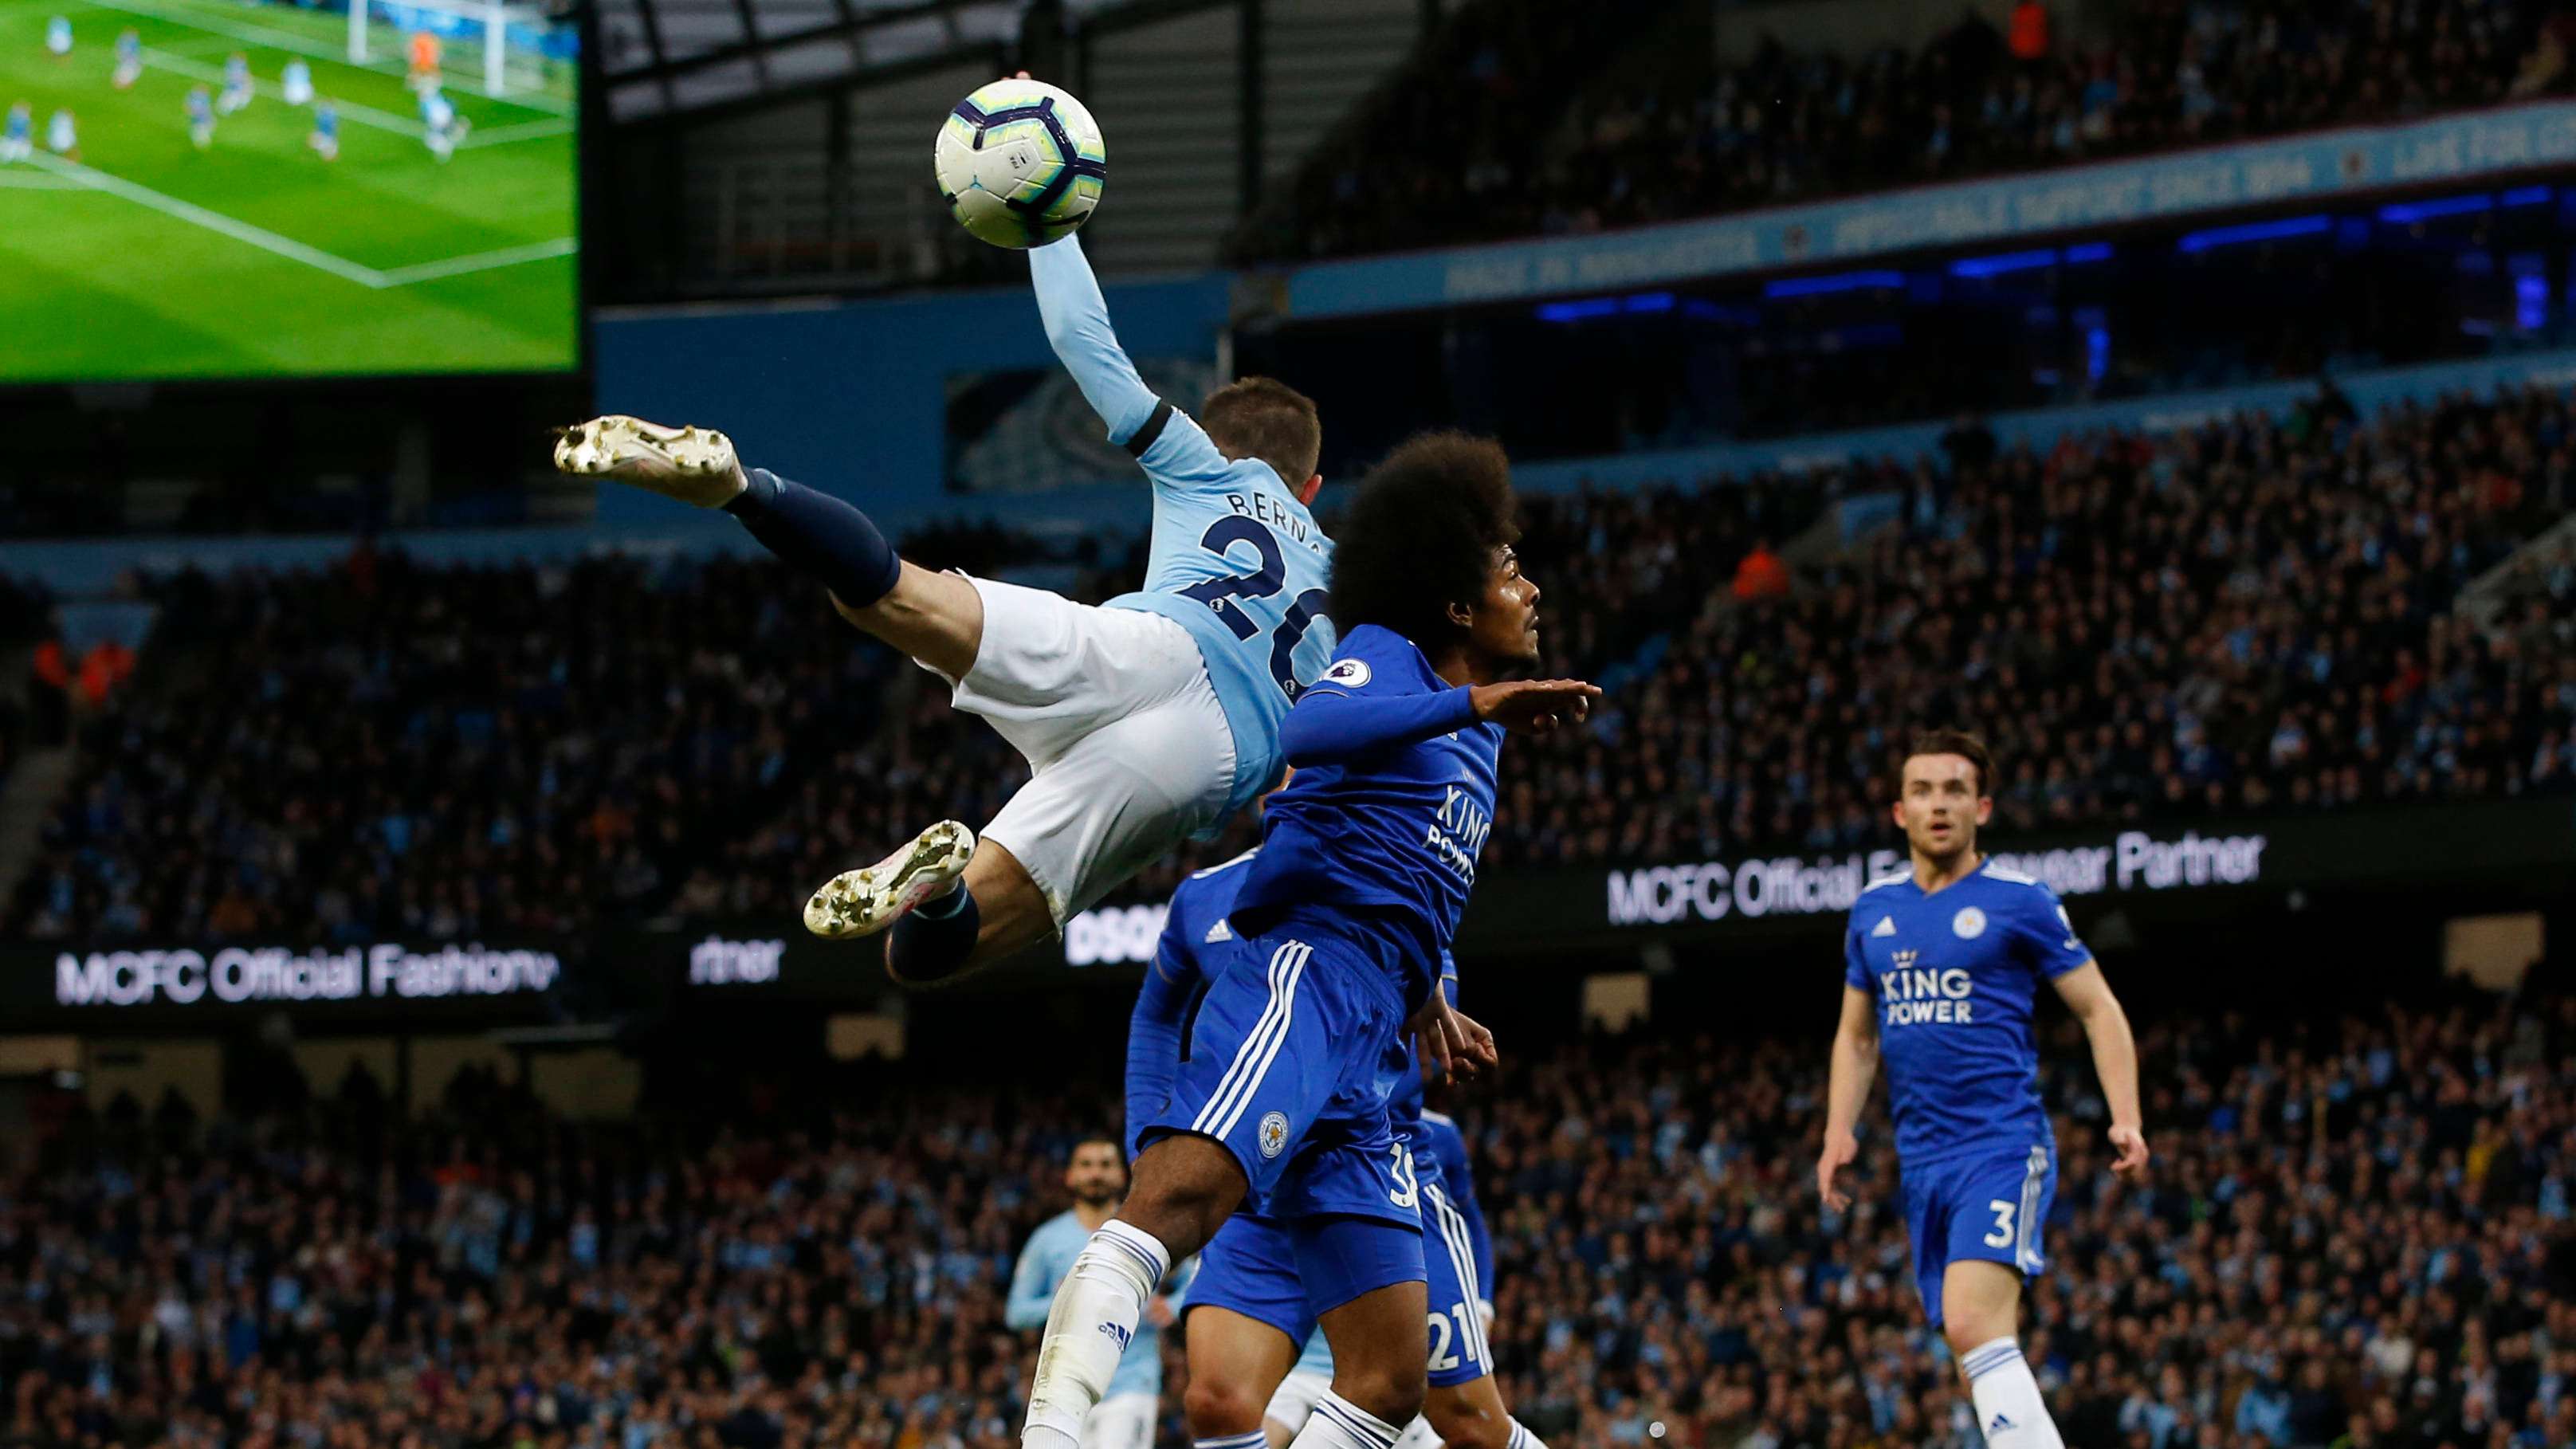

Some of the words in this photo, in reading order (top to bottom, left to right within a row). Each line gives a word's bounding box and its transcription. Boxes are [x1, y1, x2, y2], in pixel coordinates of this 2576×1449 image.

[1608, 865, 1730, 923] MCFC
[1735, 855, 1863, 916] Official
[2118, 832, 2262, 888] Partner
[57, 951, 205, 1005] MCFC
[211, 947, 362, 1002] Official
[1880, 968, 1972, 1000] KING
[1887, 999, 1972, 1025] POWER
[1984, 1199, 2016, 1249] 3
[1427, 1302, 1478, 1372] 21
